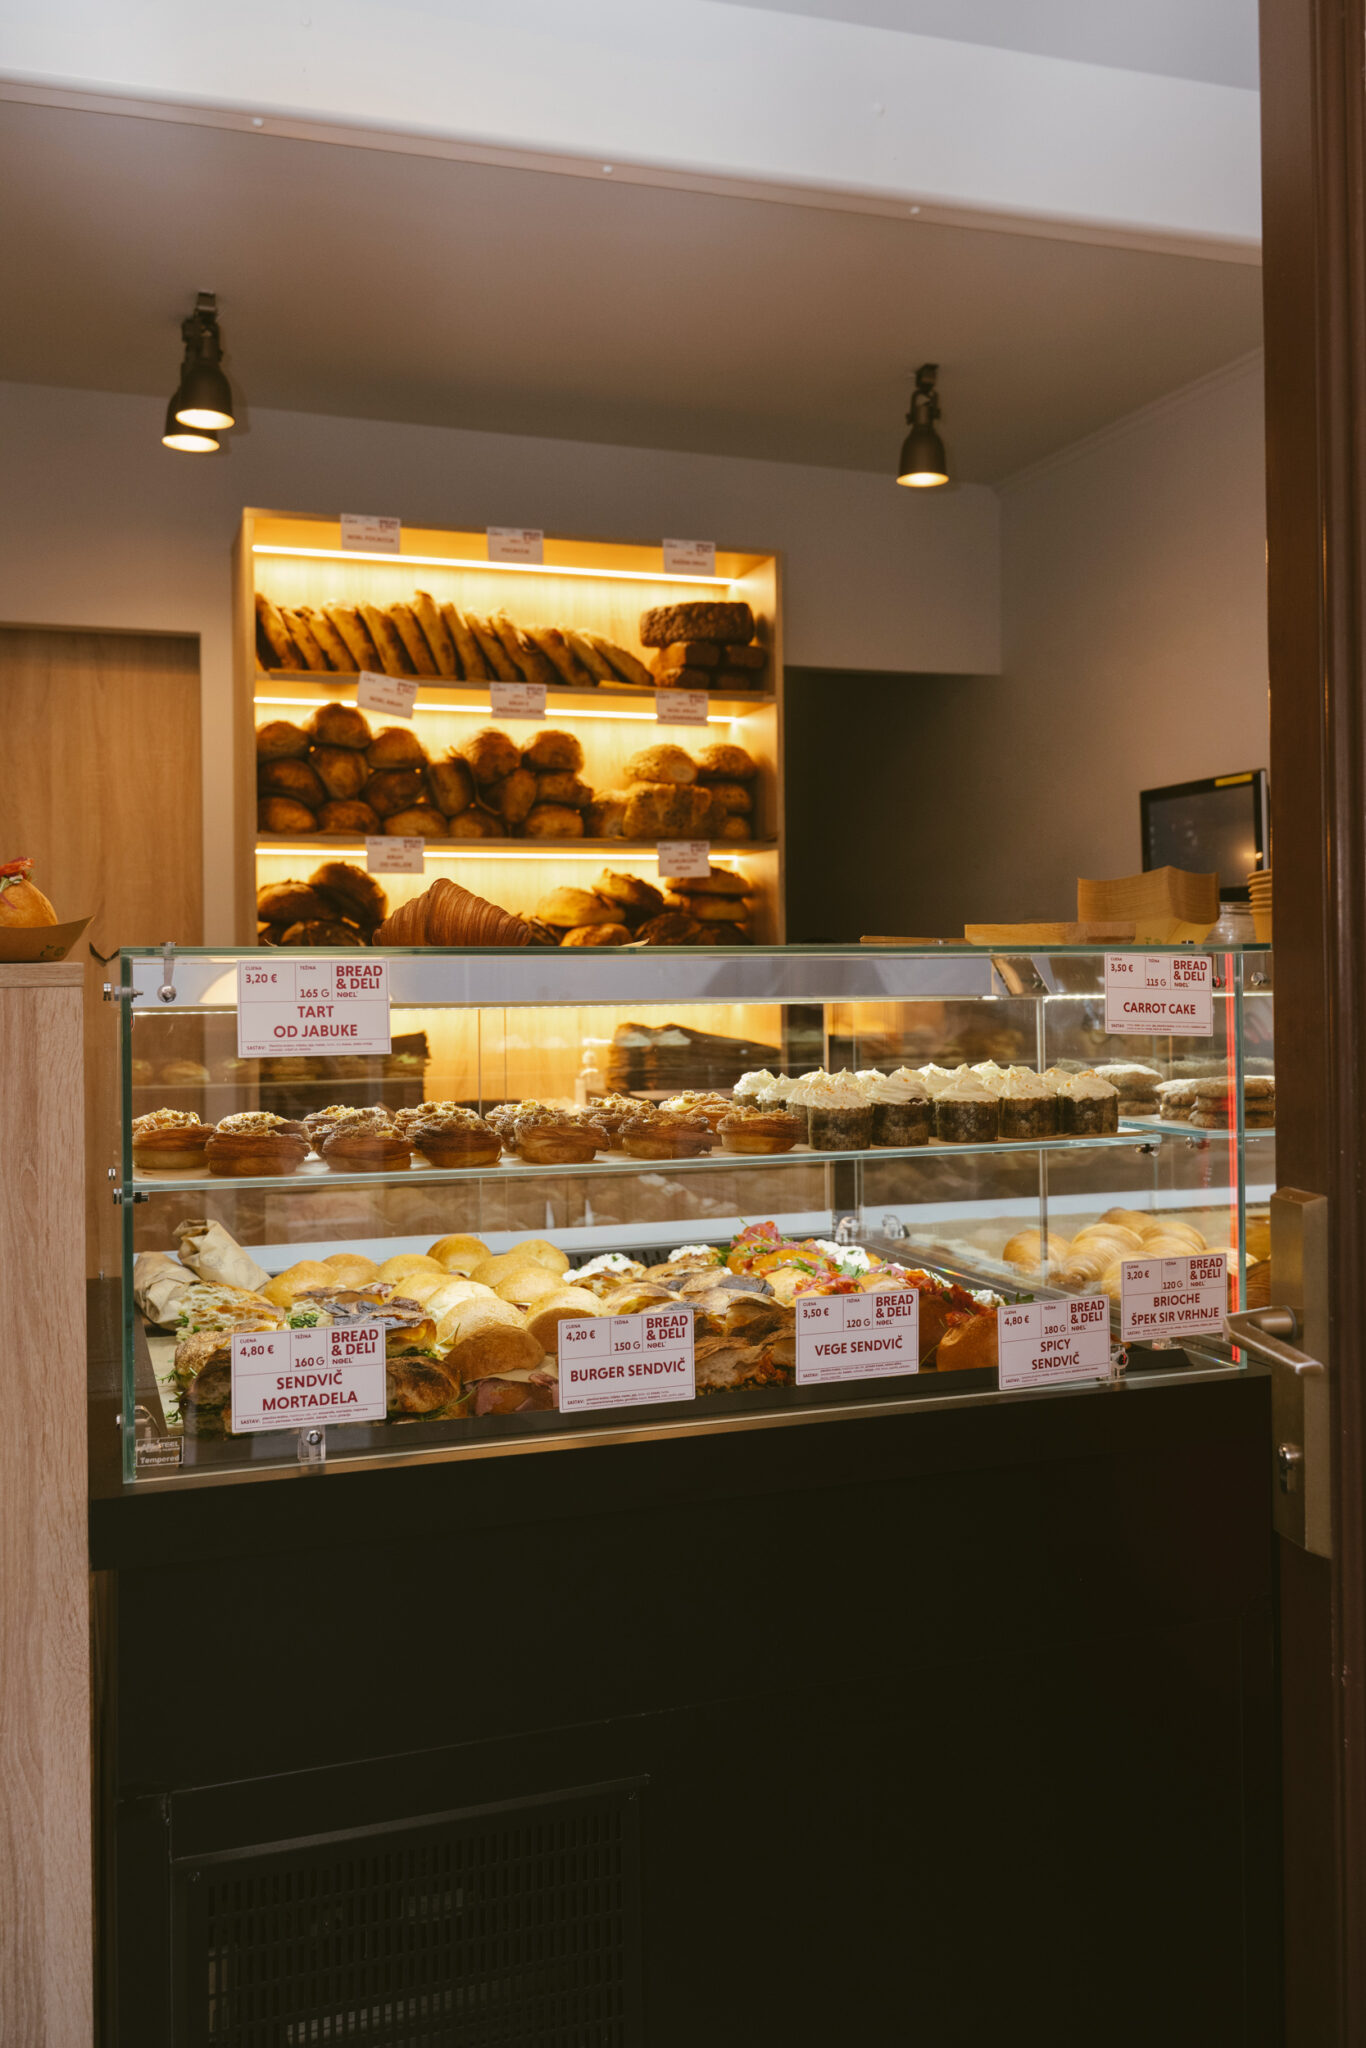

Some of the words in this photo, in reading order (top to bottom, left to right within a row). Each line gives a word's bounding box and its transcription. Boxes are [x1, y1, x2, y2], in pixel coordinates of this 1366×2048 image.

[336, 965, 383, 976] BREAD
[1111, 963, 1127, 973] 3,50
[1128, 964, 1133, 972] €
[1173, 960, 1207, 970] BREAD
[245, 974, 268, 984] 3,20
[271, 974, 277, 983] €
[1173, 970, 1181, 981] &
[1183, 971, 1205, 981] DELI
[336, 978, 347, 989] &
[350, 978, 380, 989] DELI
[1146, 978, 1158, 986] 115
[300, 989, 318, 998] 165
[321, 989, 329, 998] G
[297, 1006, 334, 1018] TART
[1123, 1002, 1166, 1013] CARROT
[1168, 1004, 1196, 1015] CAKE
[274, 1026, 298, 1038] OD
[301, 1024, 358, 1037] JABUKE
[1190, 1257, 1223, 1270] BREAD
[1127, 1271, 1143, 1280] 3,20
[1145, 1270, 1149, 1278] €
[1190, 1270, 1197, 1280] &
[1200, 1269, 1220, 1279] DELI
[1162, 1281, 1175, 1290] 120
[1177, 1280, 1183, 1288] G
[876, 1294, 913, 1307] BREAD
[1153, 1293, 1200, 1307] BRIOCHE
[876, 1308, 884, 1318] &
[887, 1306, 911, 1318] DELI
[1070, 1300, 1105, 1313] BREAD
[803, 1309, 821, 1319] 3,50
[824, 1308, 829, 1316] €
[1071, 1314, 1078, 1324] &
[1081, 1311, 1103, 1323] DELI
[1131, 1312, 1157, 1326] ŠPEK
[1159, 1312, 1175, 1323] SIR
[1177, 1307, 1219, 1321] VRHNJE
[646, 1315, 688, 1329] BREAD
[847, 1319, 861, 1328] 120
[1004, 1316, 1022, 1326] 4,80
[1024, 1315, 1029, 1323] €
[646, 1330, 656, 1341] &
[659, 1327, 685, 1340] DELI
[1044, 1326, 1058, 1334] 180
[1060, 1324, 1066, 1332] G
[331, 1329, 379, 1343] BREAD
[566, 1331, 587, 1342] 4,20
[590, 1330, 595, 1339] €
[240, 1346, 264, 1357] 4,80
[268, 1345, 274, 1354] €
[331, 1345, 342, 1356] &
[346, 1342, 375, 1355] DELI
[614, 1342, 631, 1352] 150
[633, 1341, 640, 1350] G
[815, 1342, 847, 1356] VEGE
[851, 1335, 902, 1353] SENDVIČ
[1040, 1339, 1071, 1352] SPICY
[295, 1358, 314, 1368] 160
[316, 1357, 325, 1366] G
[1032, 1352, 1080, 1370] SENDVIČ
[570, 1366, 625, 1382] BURGER
[628, 1357, 685, 1377] SENDVIČ
[277, 1369, 342, 1390] SENDVIČ
[262, 1391, 357, 1411] MORTADELA
